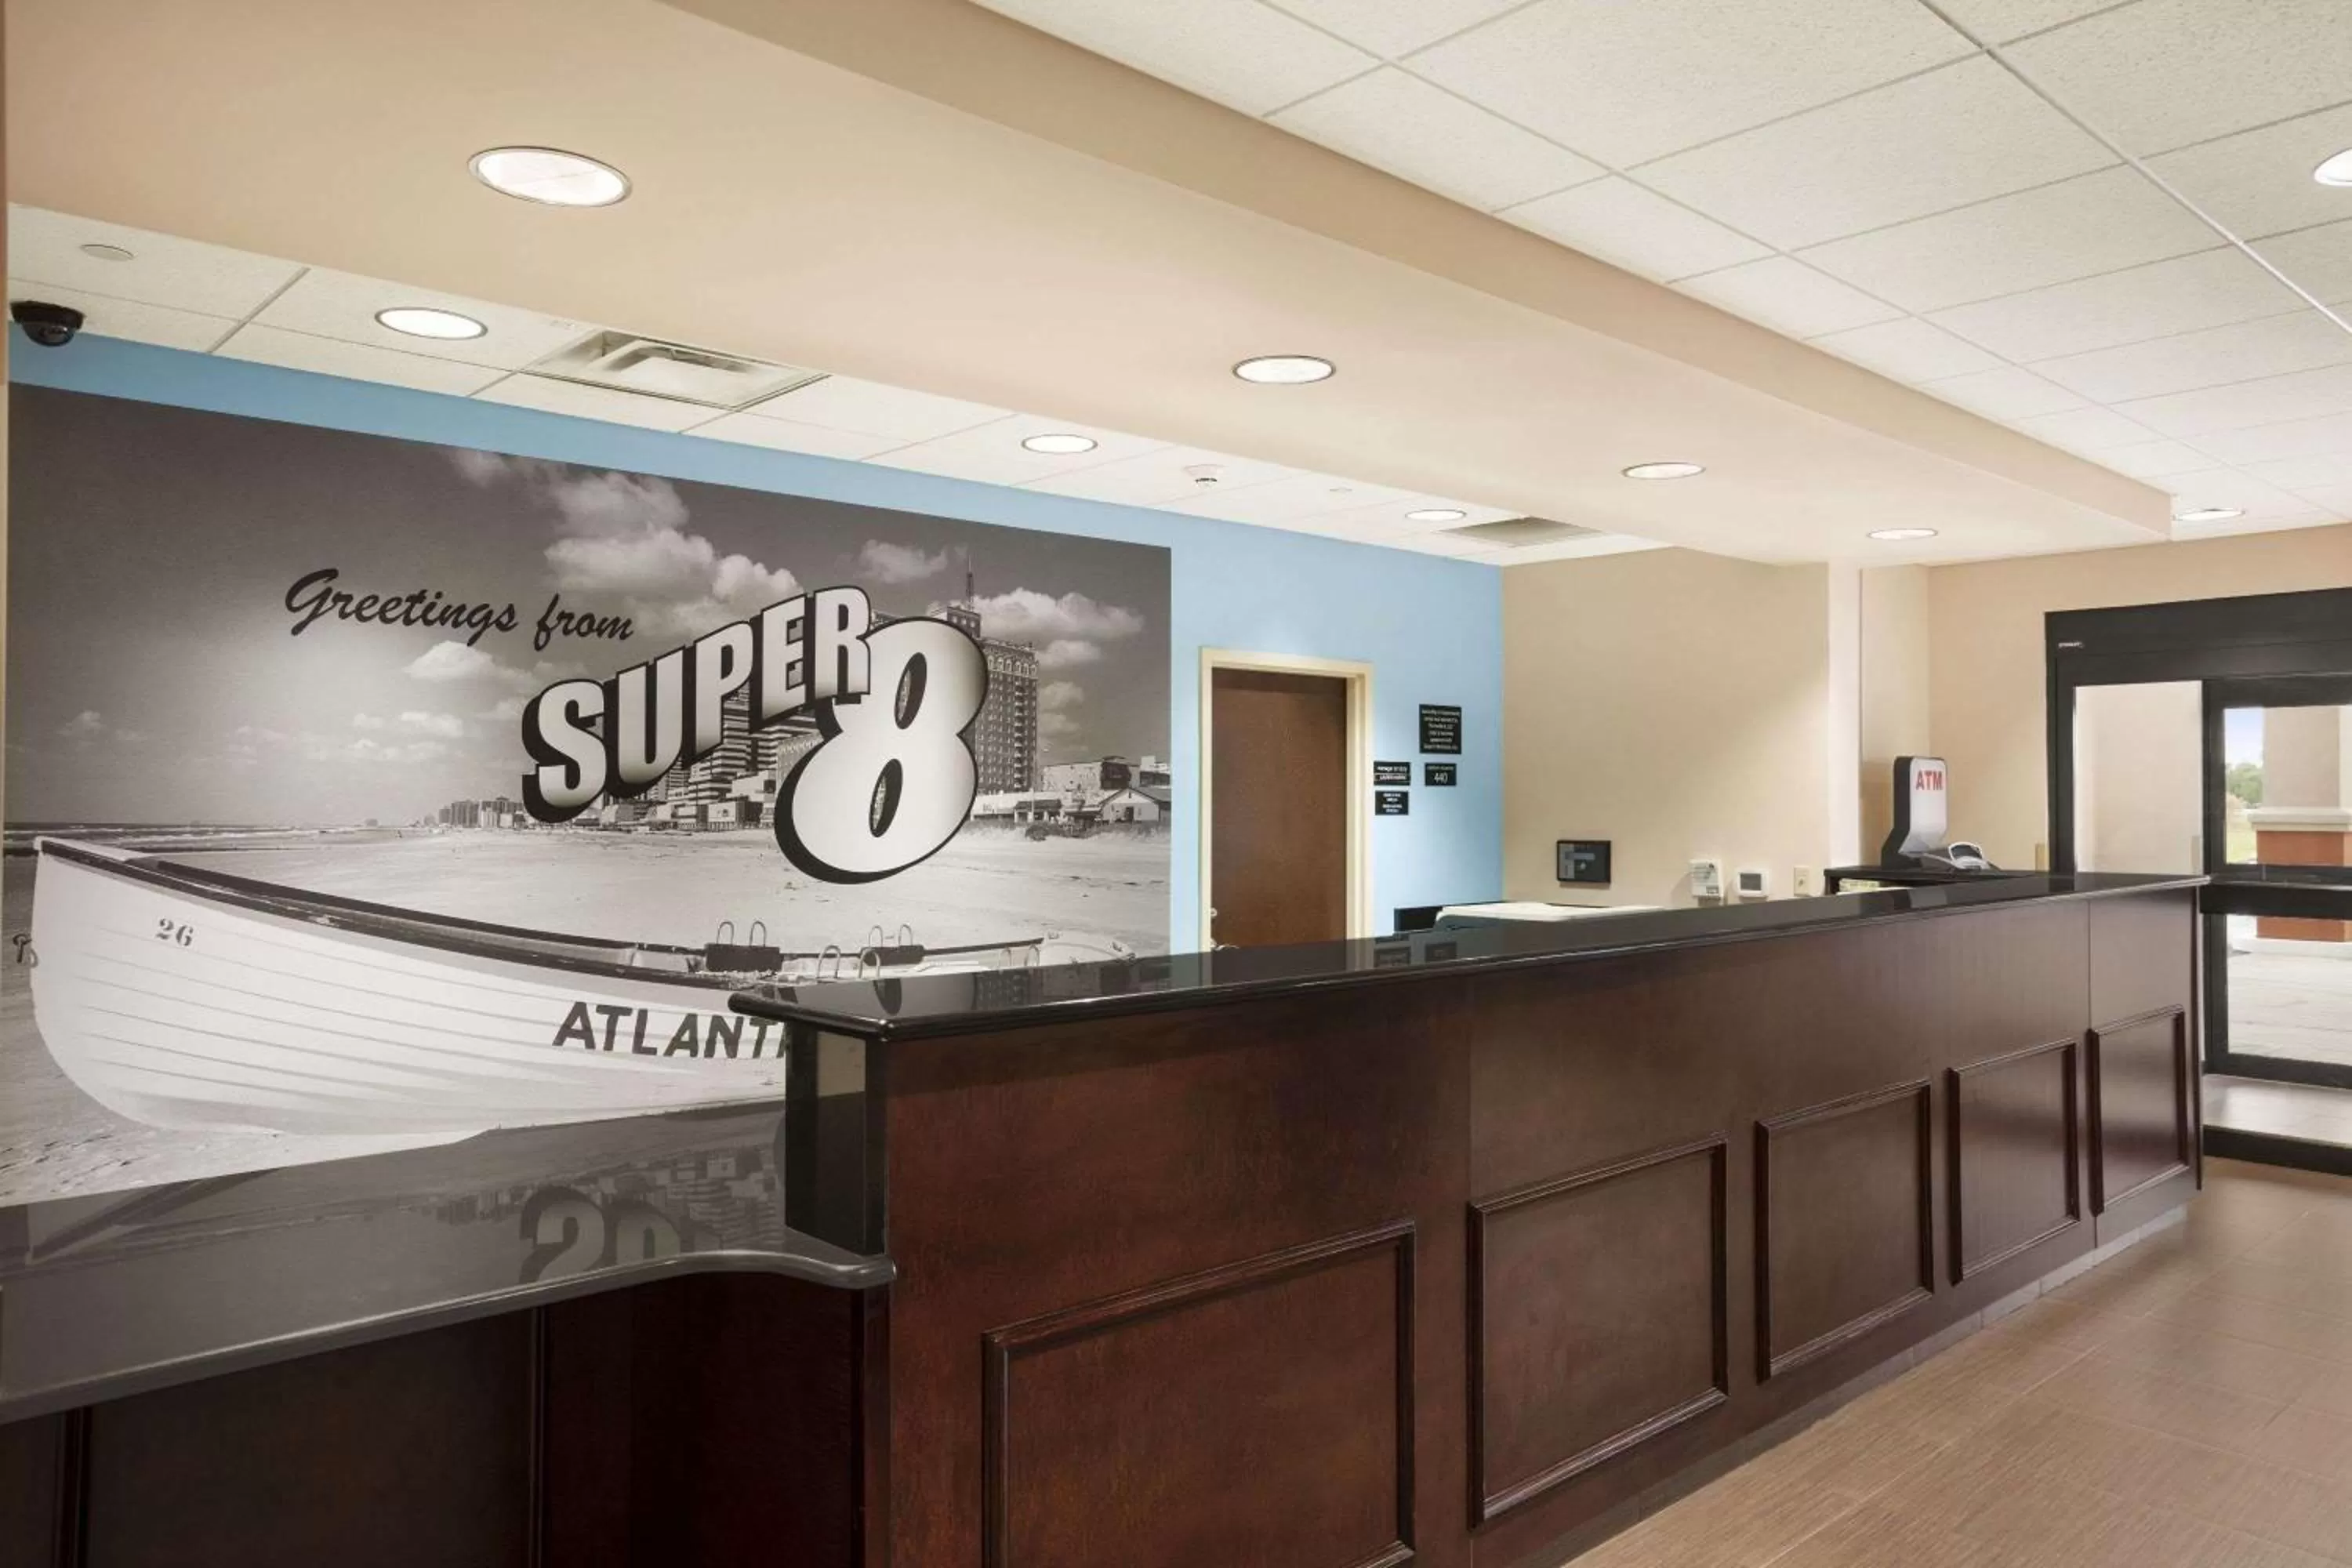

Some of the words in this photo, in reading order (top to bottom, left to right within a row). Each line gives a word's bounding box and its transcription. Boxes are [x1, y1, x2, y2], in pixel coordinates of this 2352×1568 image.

[285, 568, 518, 648] Greetings
[533, 593, 634, 652] from
[522, 585, 871, 823] SUPER
[774, 615, 989, 884] 8
[1915, 770, 1944, 790] ATM
[155, 917, 194, 947] 26
